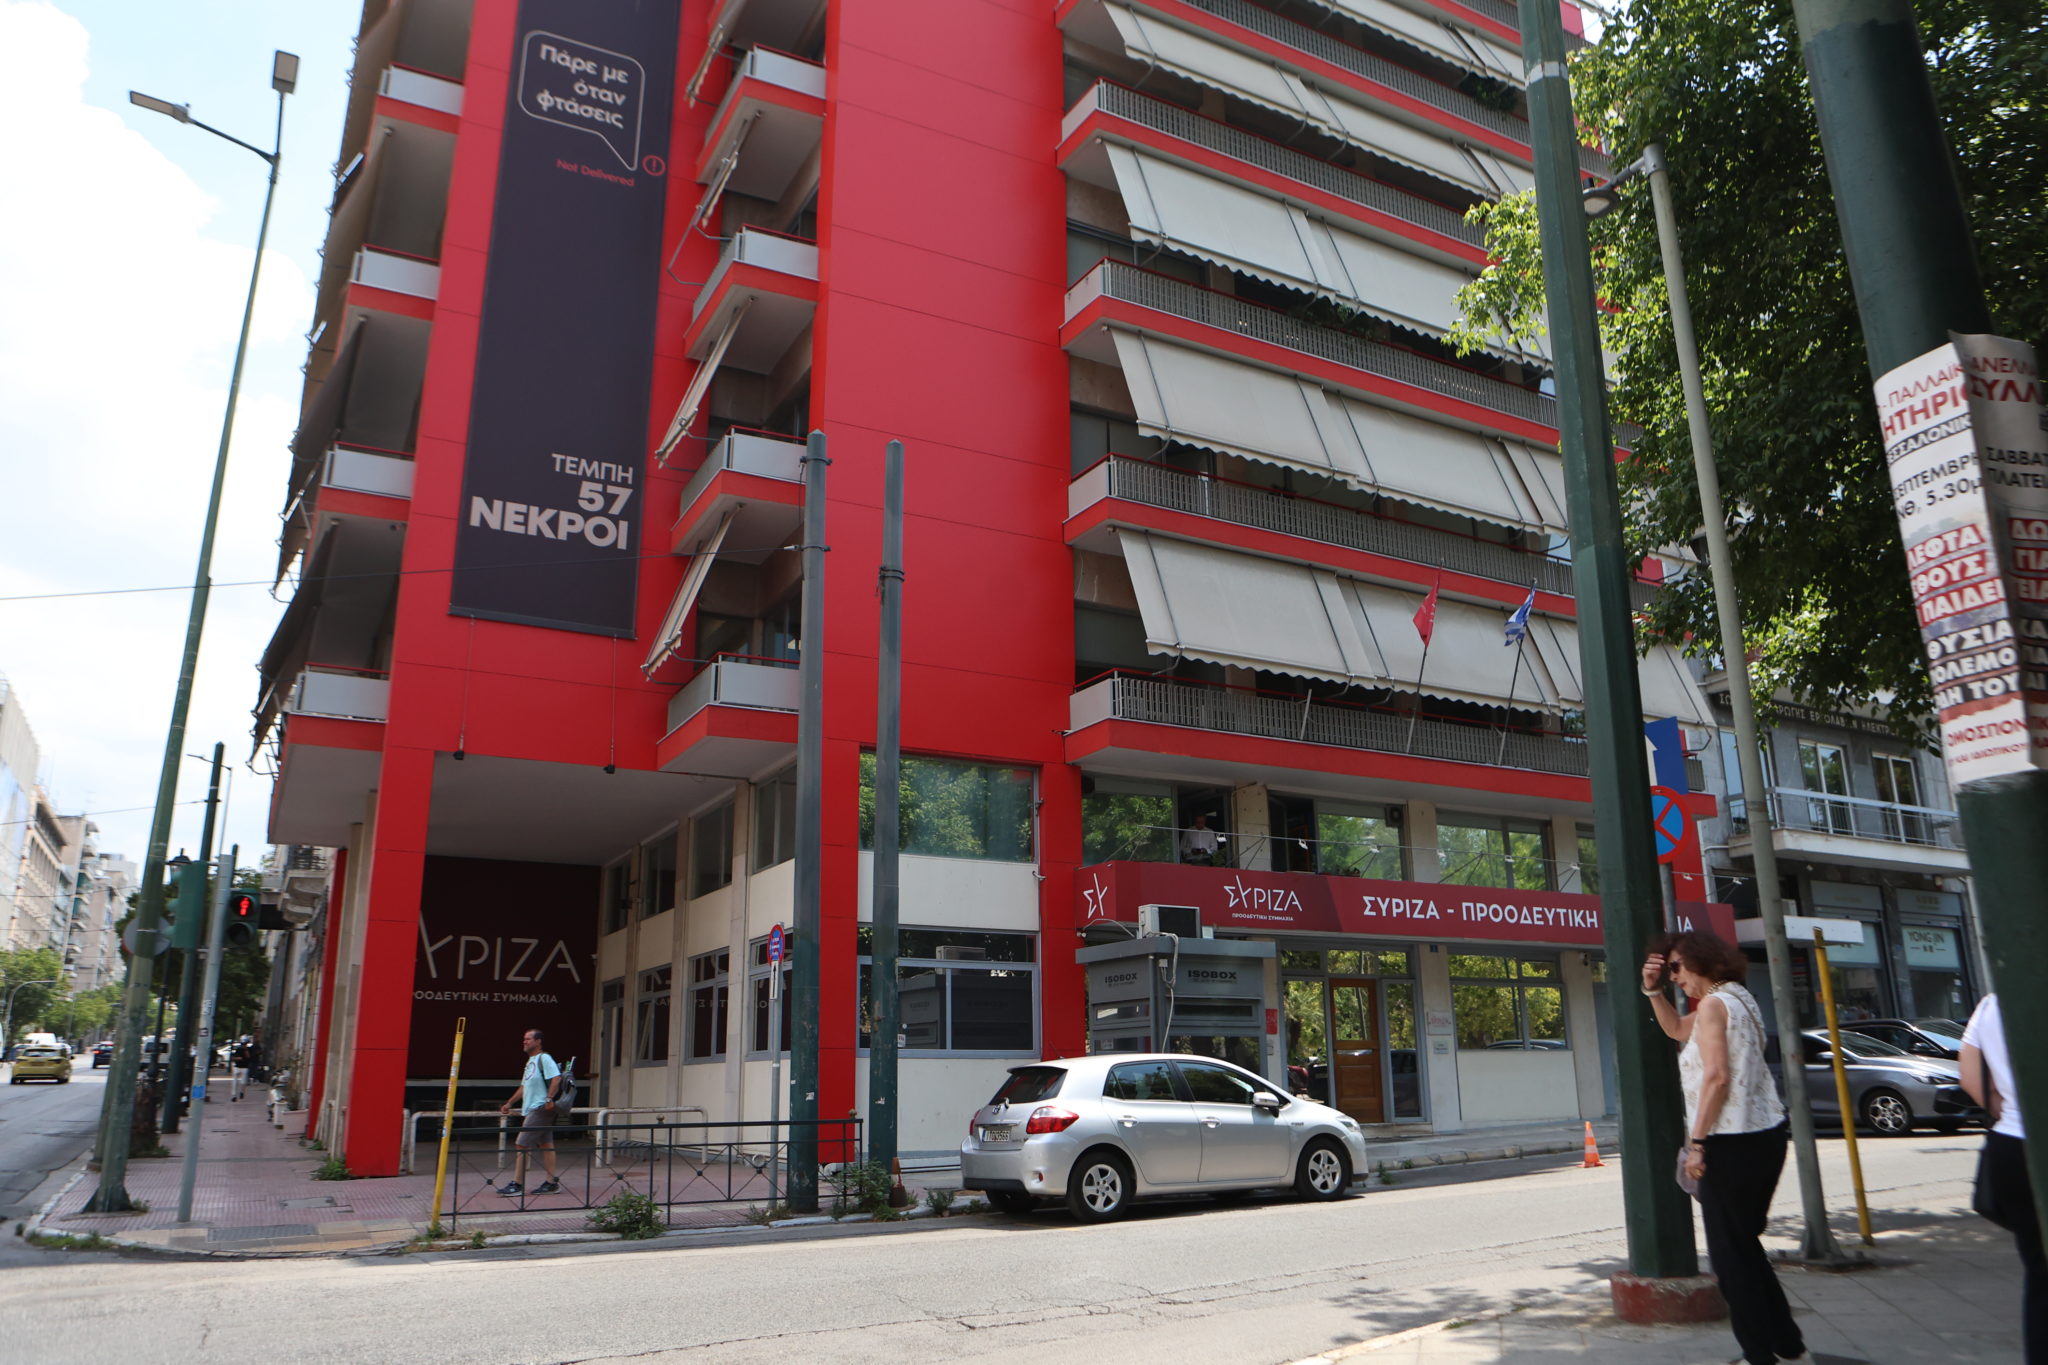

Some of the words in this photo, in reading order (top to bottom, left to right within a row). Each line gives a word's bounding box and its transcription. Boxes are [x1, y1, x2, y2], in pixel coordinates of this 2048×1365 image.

[539, 43, 598, 75] Πάρε
[602, 65, 629, 84] με
[536, 88, 624, 129] φτάσεις
[573, 78, 626, 106] όταν
[556, 158, 579, 173] Not
[580, 164, 635, 187] Delivered
[552, 453, 633, 484] ΤΕΜΠΗ
[577, 480, 633, 516] 57
[469, 495, 629, 550] ΝΕΚΡΟΙ
[1223, 874, 1303, 912] ΣΥΡΙΖΑ
[1362, 896, 1440, 920] ΣΥΡΙΖΑ
[1462, 901, 1599, 929] ΠΡΟΟΔΕΥΤΙΚΗ
[419, 909, 581, 984] ΥΡΙΖΑ
[1104, 972, 1137, 984] ISOBOX
[1188, 969, 1237, 980] ISOBOX
[493, 992, 559, 1004] ΣΥΜΜΑΧΙΑ
